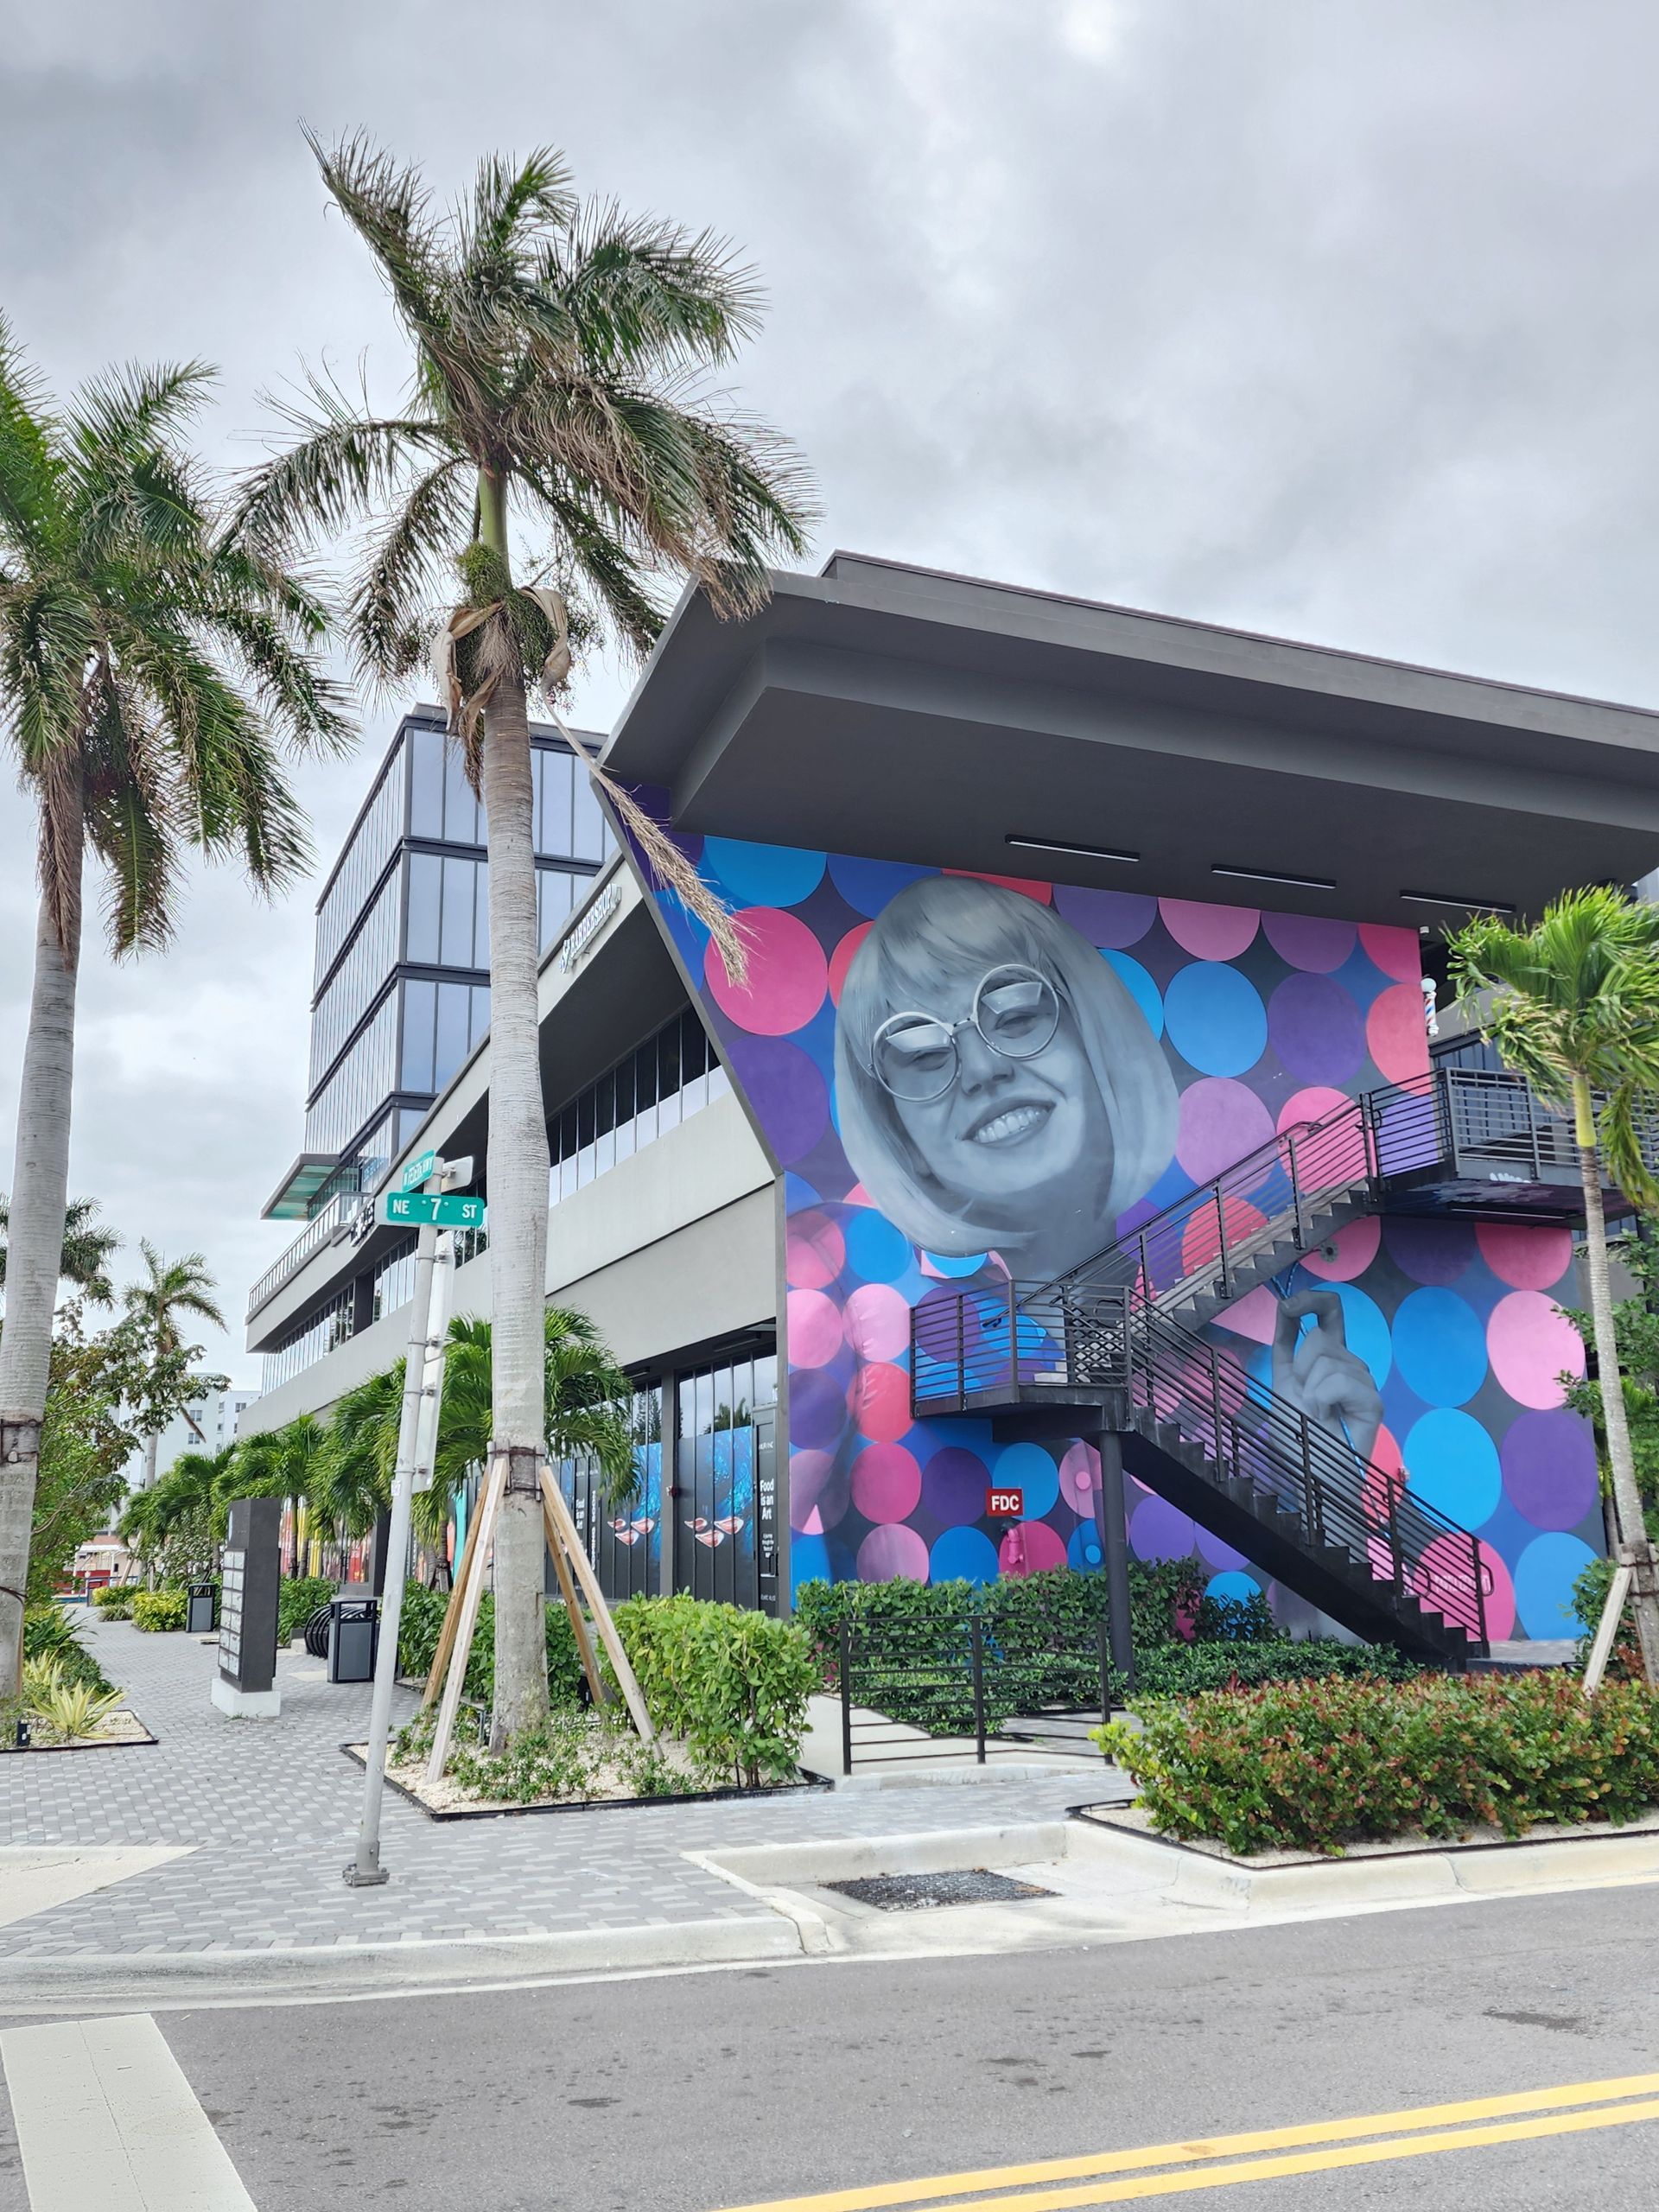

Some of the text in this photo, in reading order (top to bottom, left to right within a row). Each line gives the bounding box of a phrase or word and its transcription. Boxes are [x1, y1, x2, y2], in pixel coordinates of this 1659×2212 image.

[570, 883, 613, 958] BARBERSHOP
[392, 1197, 478, 1221] NE 7 ST
[760, 1478, 774, 1492] Food
[991, 1495, 1020, 1511] FDC
[761, 1506, 772, 1521] Art
